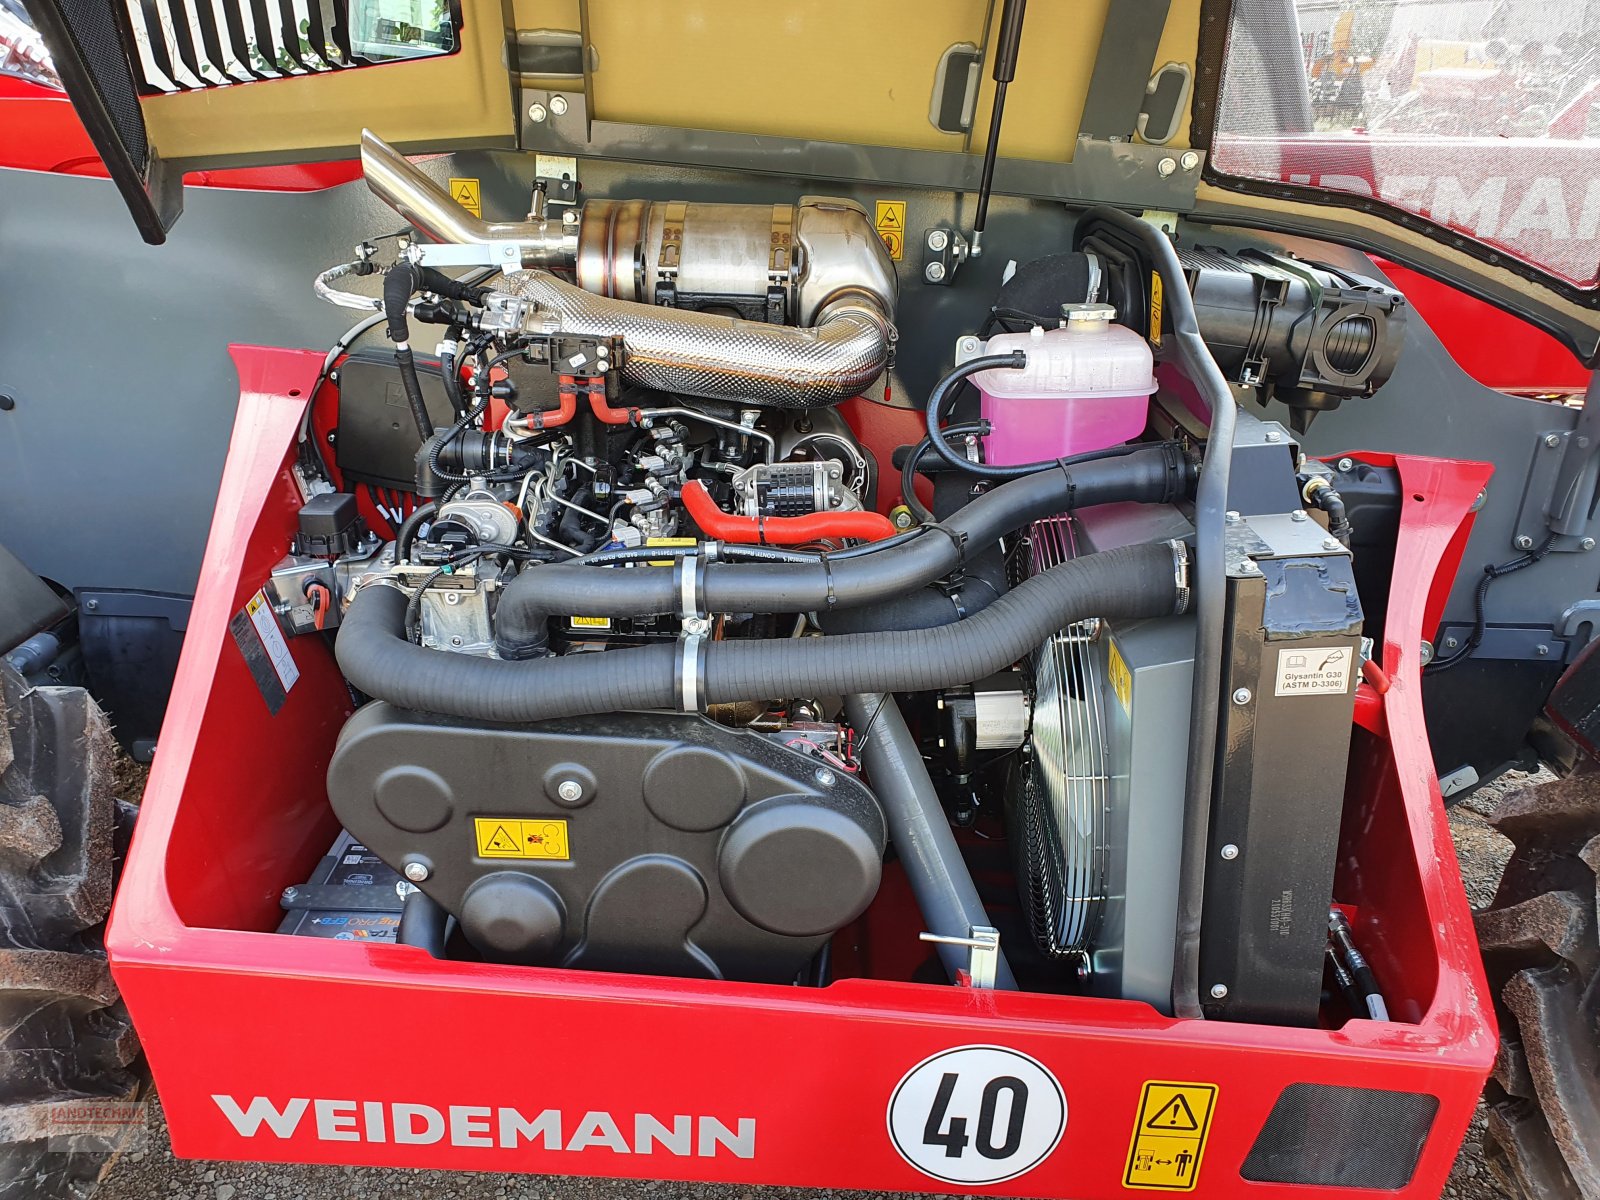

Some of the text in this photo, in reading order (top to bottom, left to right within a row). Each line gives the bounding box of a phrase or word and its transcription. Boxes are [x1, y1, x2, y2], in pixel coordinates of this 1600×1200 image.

[1282, 680, 1342, 690] (ASTM D-3306)
[1285, 671, 1342, 681] Glysantin G30
[210, 1094, 756, 1159] WEIDEMANN
[922, 1072, 1029, 1160] 40
